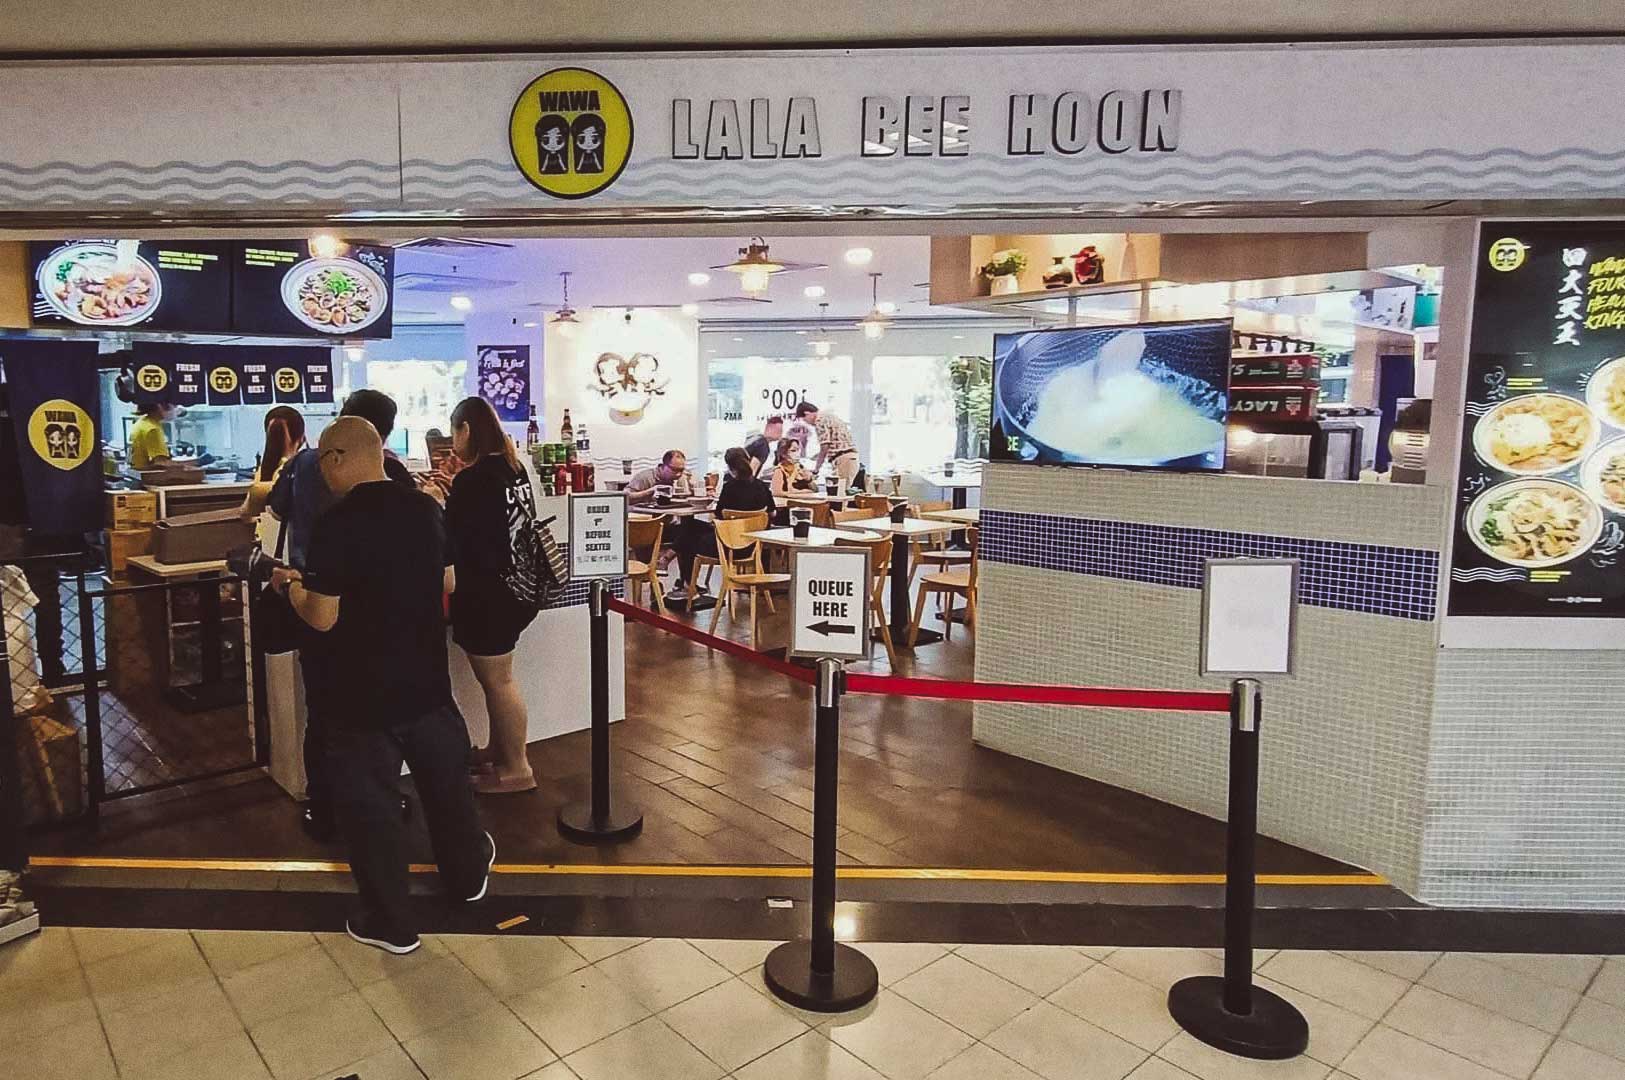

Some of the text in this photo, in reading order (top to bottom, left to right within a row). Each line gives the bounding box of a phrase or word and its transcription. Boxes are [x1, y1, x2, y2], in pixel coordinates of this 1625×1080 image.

[539, 90, 600, 112] WAWA
[672, 88, 1182, 160] LALA BEE HOON
[1552, 247, 1588, 346] 四大天王
[808, 579, 853, 596] QUEUE
[813, 601, 848, 618] HERE
